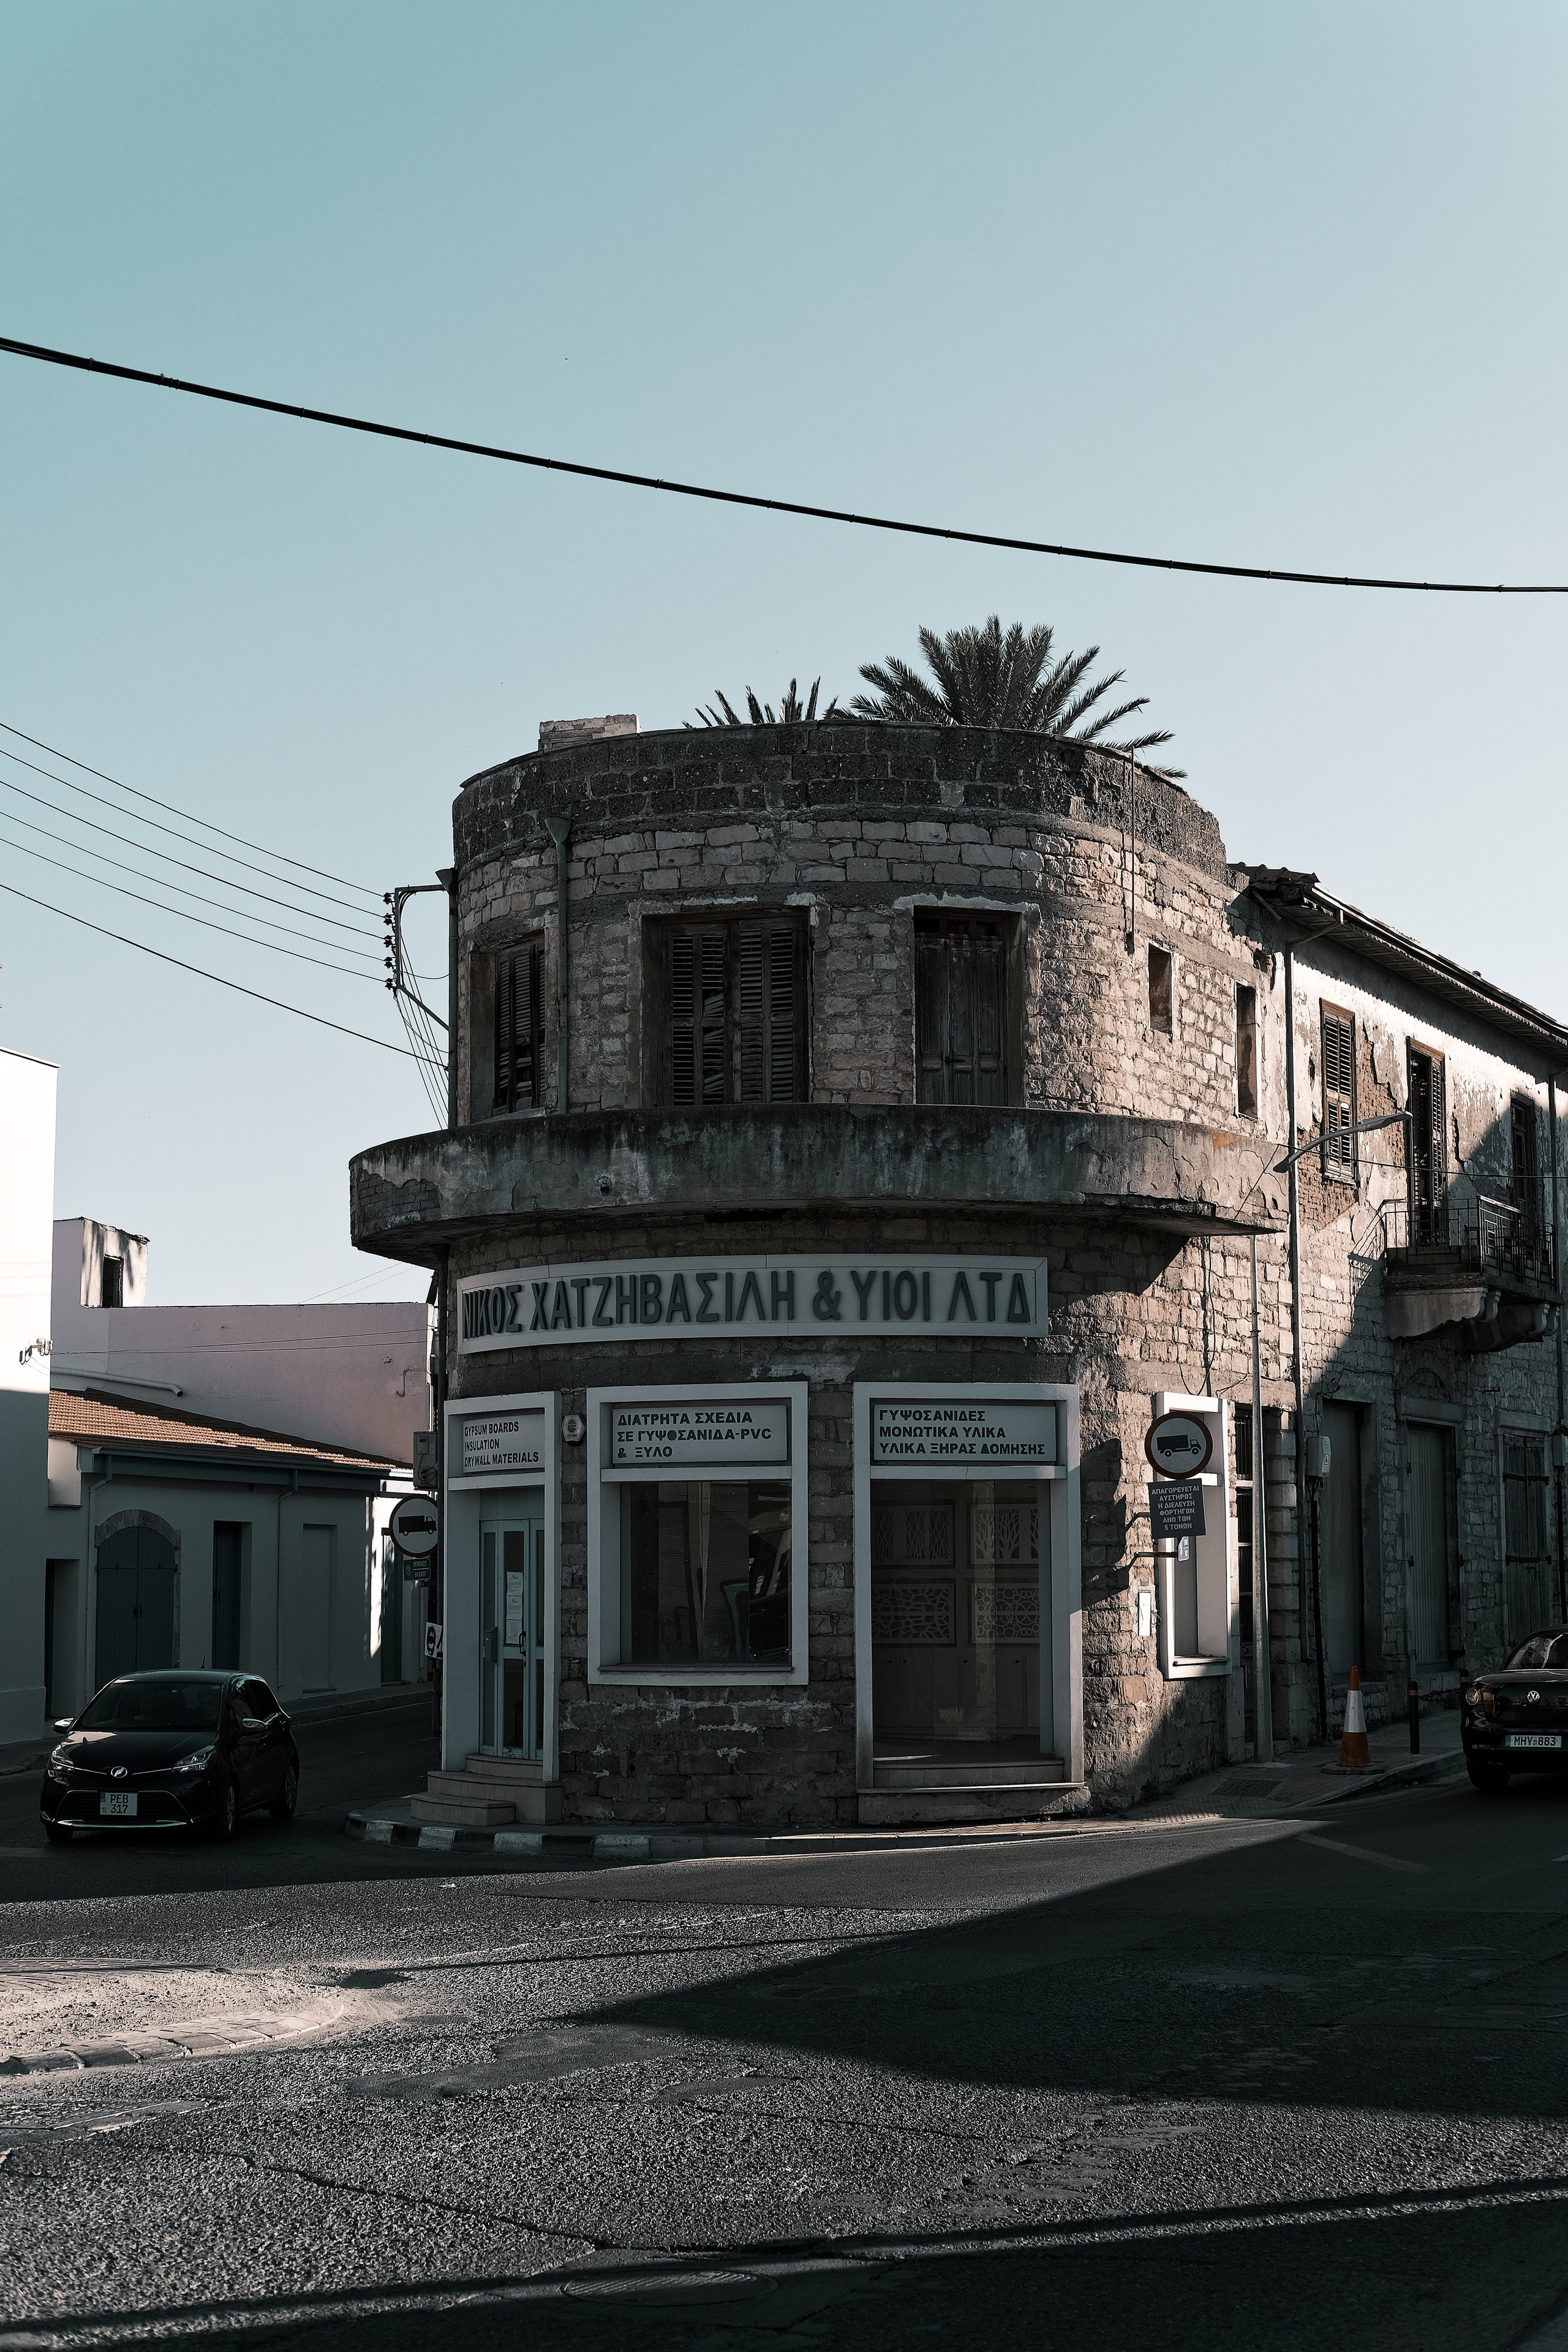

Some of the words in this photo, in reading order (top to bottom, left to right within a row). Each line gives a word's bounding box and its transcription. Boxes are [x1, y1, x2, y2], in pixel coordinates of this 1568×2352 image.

[463, 1284, 522, 1339] ΝΙΚΟΣ
[530, 1271, 794, 1330] ΧΑΤΖΗΒΑΣΙΛΗ
[813, 1271, 840, 1321] &
[850, 1270, 930, 1321] ΥΙΟΙ
[948, 1271, 1031, 1322] ΛΤΔ
[618, 1413, 690, 1425] ΔΙΑΤΡΗΤΑ
[695, 1412, 753, 1423] ΣΧΕΔΙΑ
[880, 1410, 986, 1422] ΓΥΨΟΣΑΝΙΔΕΣ
[465, 1424, 487, 1437] GYPSUM
[489, 1422, 519, 1434] BOARDS
[617, 1431, 633, 1442] ΣΕ
[638, 1428, 772, 1441] ΓΥΨΟΣΑΝΙΔΑ-PVC
[880, 1427, 959, 1438] ΜΟΝΩΤΙΚΑ
[962, 1427, 1006, 1438] ΥΛΙΚΑ
[465, 1439, 499, 1452] INSULATION
[879, 1442, 926, 1453] ΥΛΙΚΑ
[930, 1443, 976, 1454] ΞΗΡΑΣ
[980, 1443, 1045, 1455] ΔΟΜΗΣΗΣ
[617, 1447, 627, 1458] &
[635, 1446, 673, 1458] ΞΥΛΟ
[465, 1455, 491, 1467] DRYWALL
[492, 1452, 539, 1464] MATERIALS
[1152, 1485, 1199, 1494] ΑΠΑΓΟΡΕΥΕΤΑΙ
[1514, 1736, 1532, 1746] MHY
[1538, 1736, 1556, 1746] 883
[110, 1794, 128, 1803] PEB
[111, 1804, 128, 1813] 317
